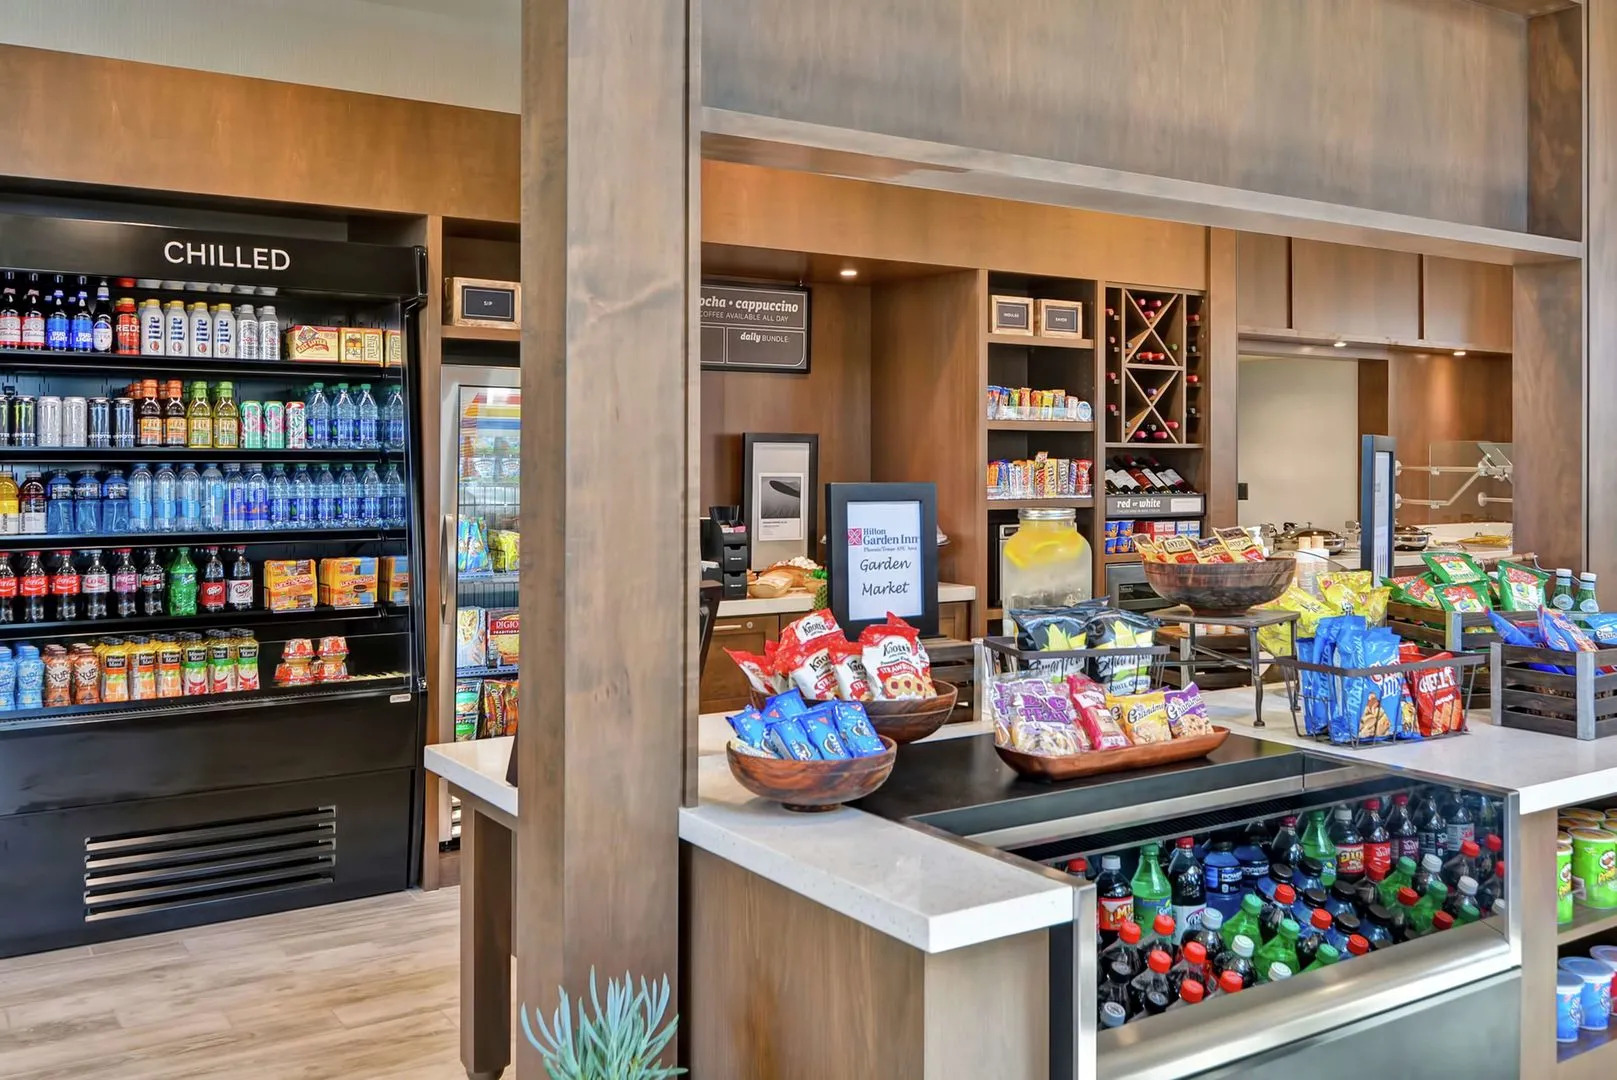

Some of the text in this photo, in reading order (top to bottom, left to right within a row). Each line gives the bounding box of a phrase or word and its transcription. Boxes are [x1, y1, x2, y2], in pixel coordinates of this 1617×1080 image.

[163, 240, 291, 271] CHILLED
[735, 299, 799, 313] cappuccino
[725, 312, 761, 321] AVAILABLE
[762, 314, 774, 322] ALL
[775, 315, 789, 323] DAY
[740, 332, 788, 343] daily BUNDLE
[1117, 498, 1131, 508] red
[1139, 498, 1161, 508] white
[863, 527, 886, 536] Hilton
[863, 534, 918, 546] Garden Inn
[860, 557, 911, 573] Garden
[861, 581, 910, 597] Market
